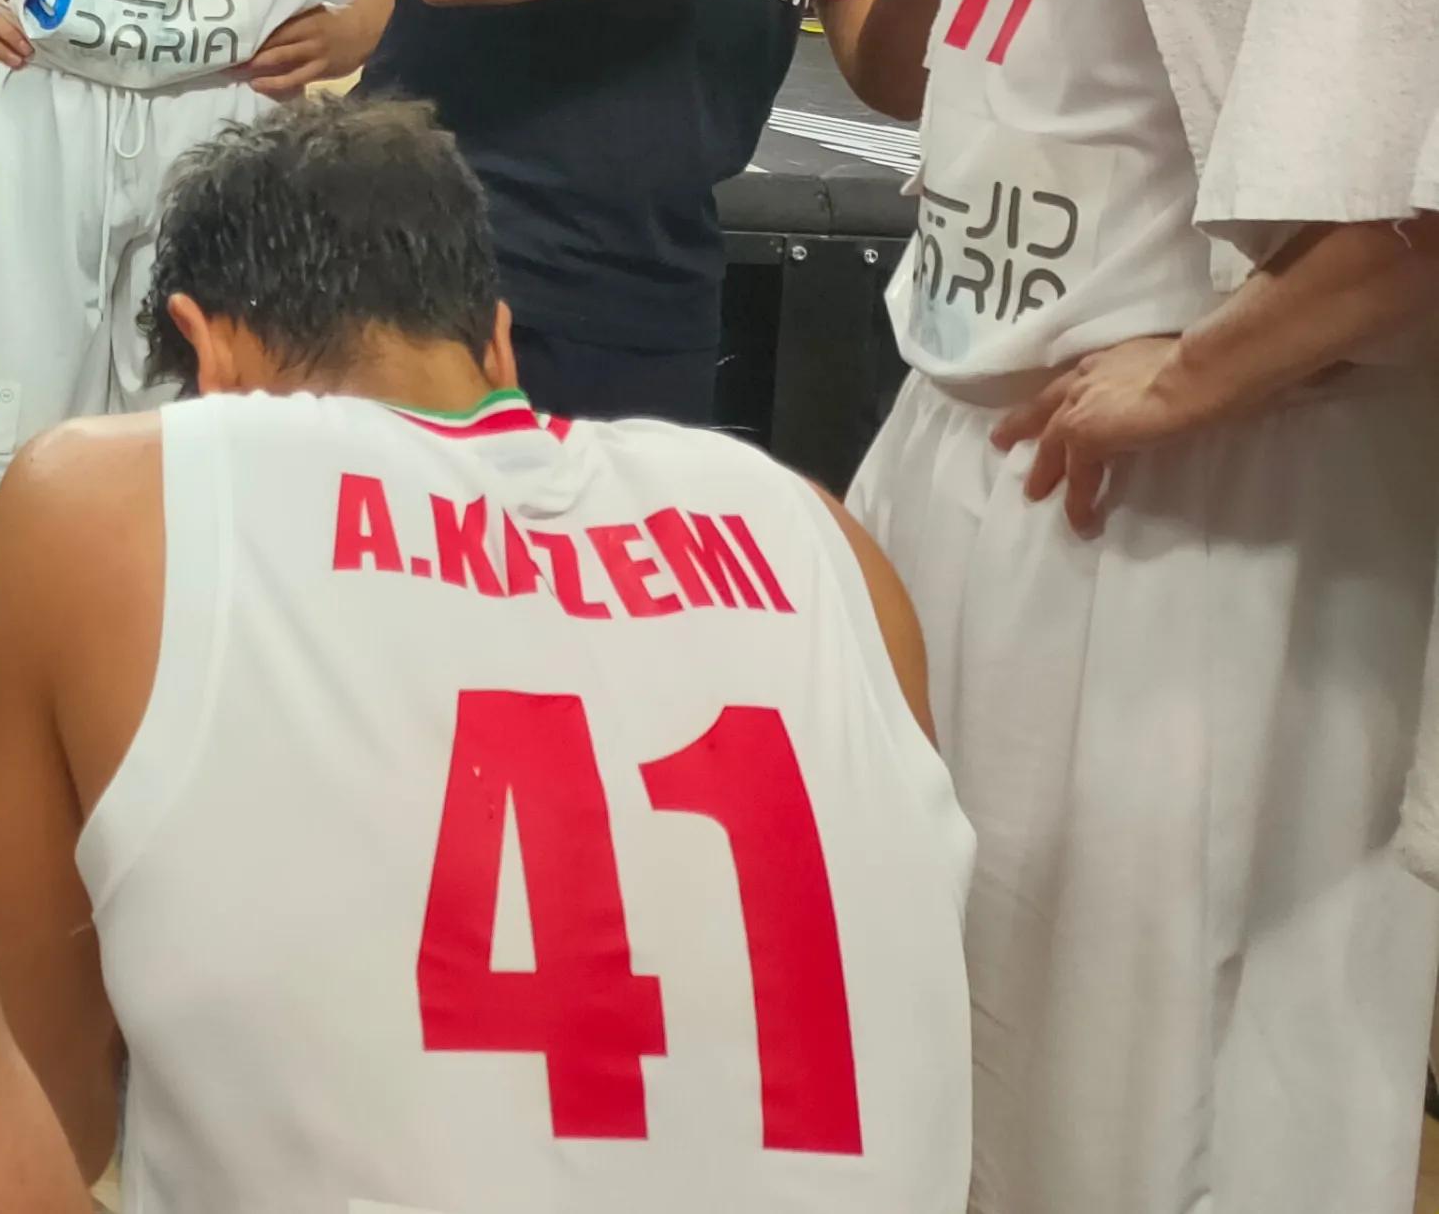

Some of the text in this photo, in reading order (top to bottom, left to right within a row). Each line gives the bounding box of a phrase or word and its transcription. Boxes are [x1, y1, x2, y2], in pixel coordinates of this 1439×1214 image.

[69, 9, 239, 65] DARIA
[331, 472, 798, 621] A.KAZEMI
[415, 689, 865, 1157] 41
